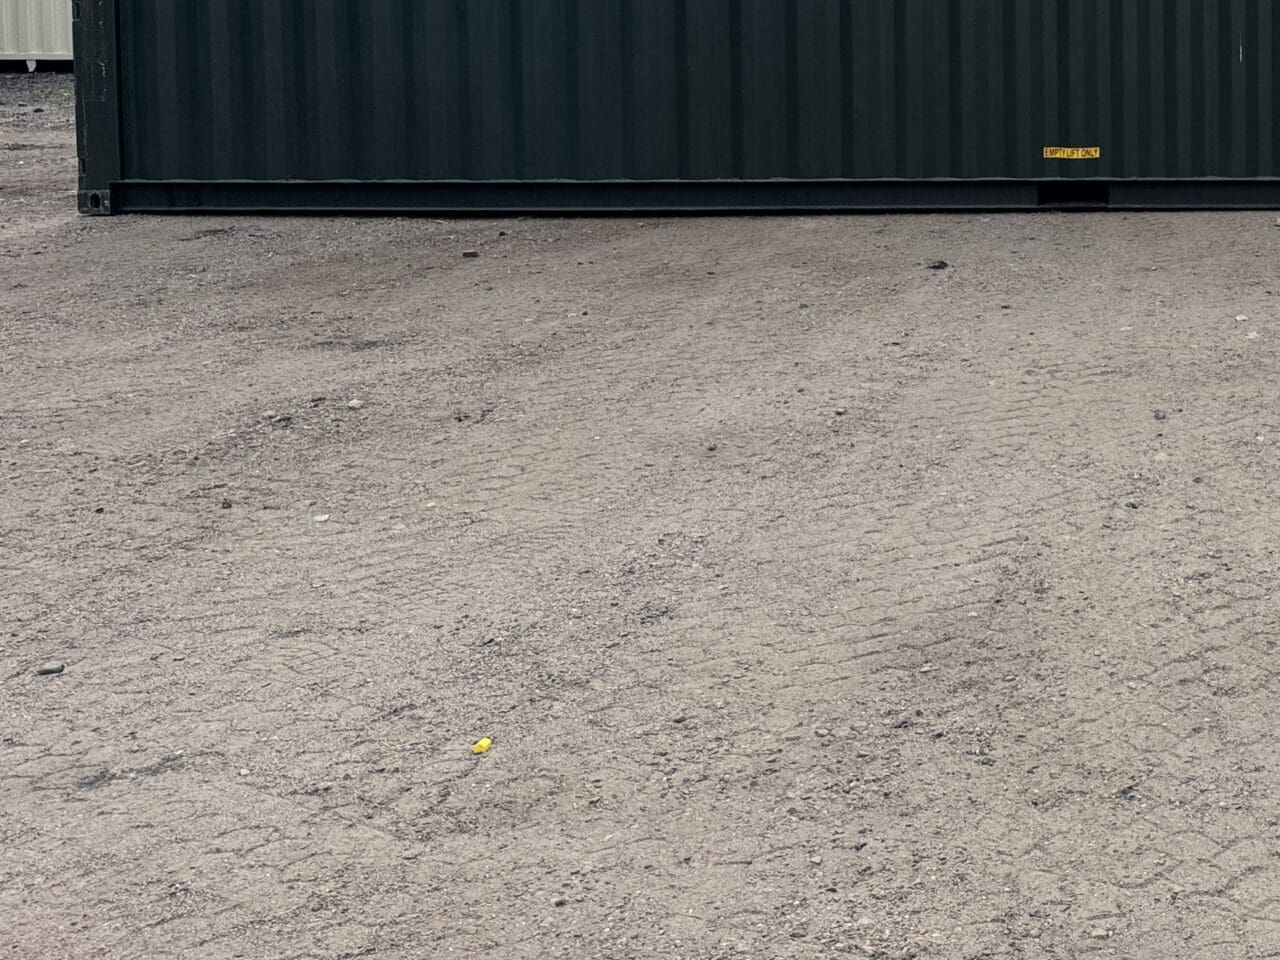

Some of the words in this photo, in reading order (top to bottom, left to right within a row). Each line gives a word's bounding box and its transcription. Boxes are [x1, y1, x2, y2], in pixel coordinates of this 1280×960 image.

[1045, 148, 1066, 157] EMPTY
[1067, 149, 1080, 158] LIFT
[1080, 149, 1098, 157] ONLY
